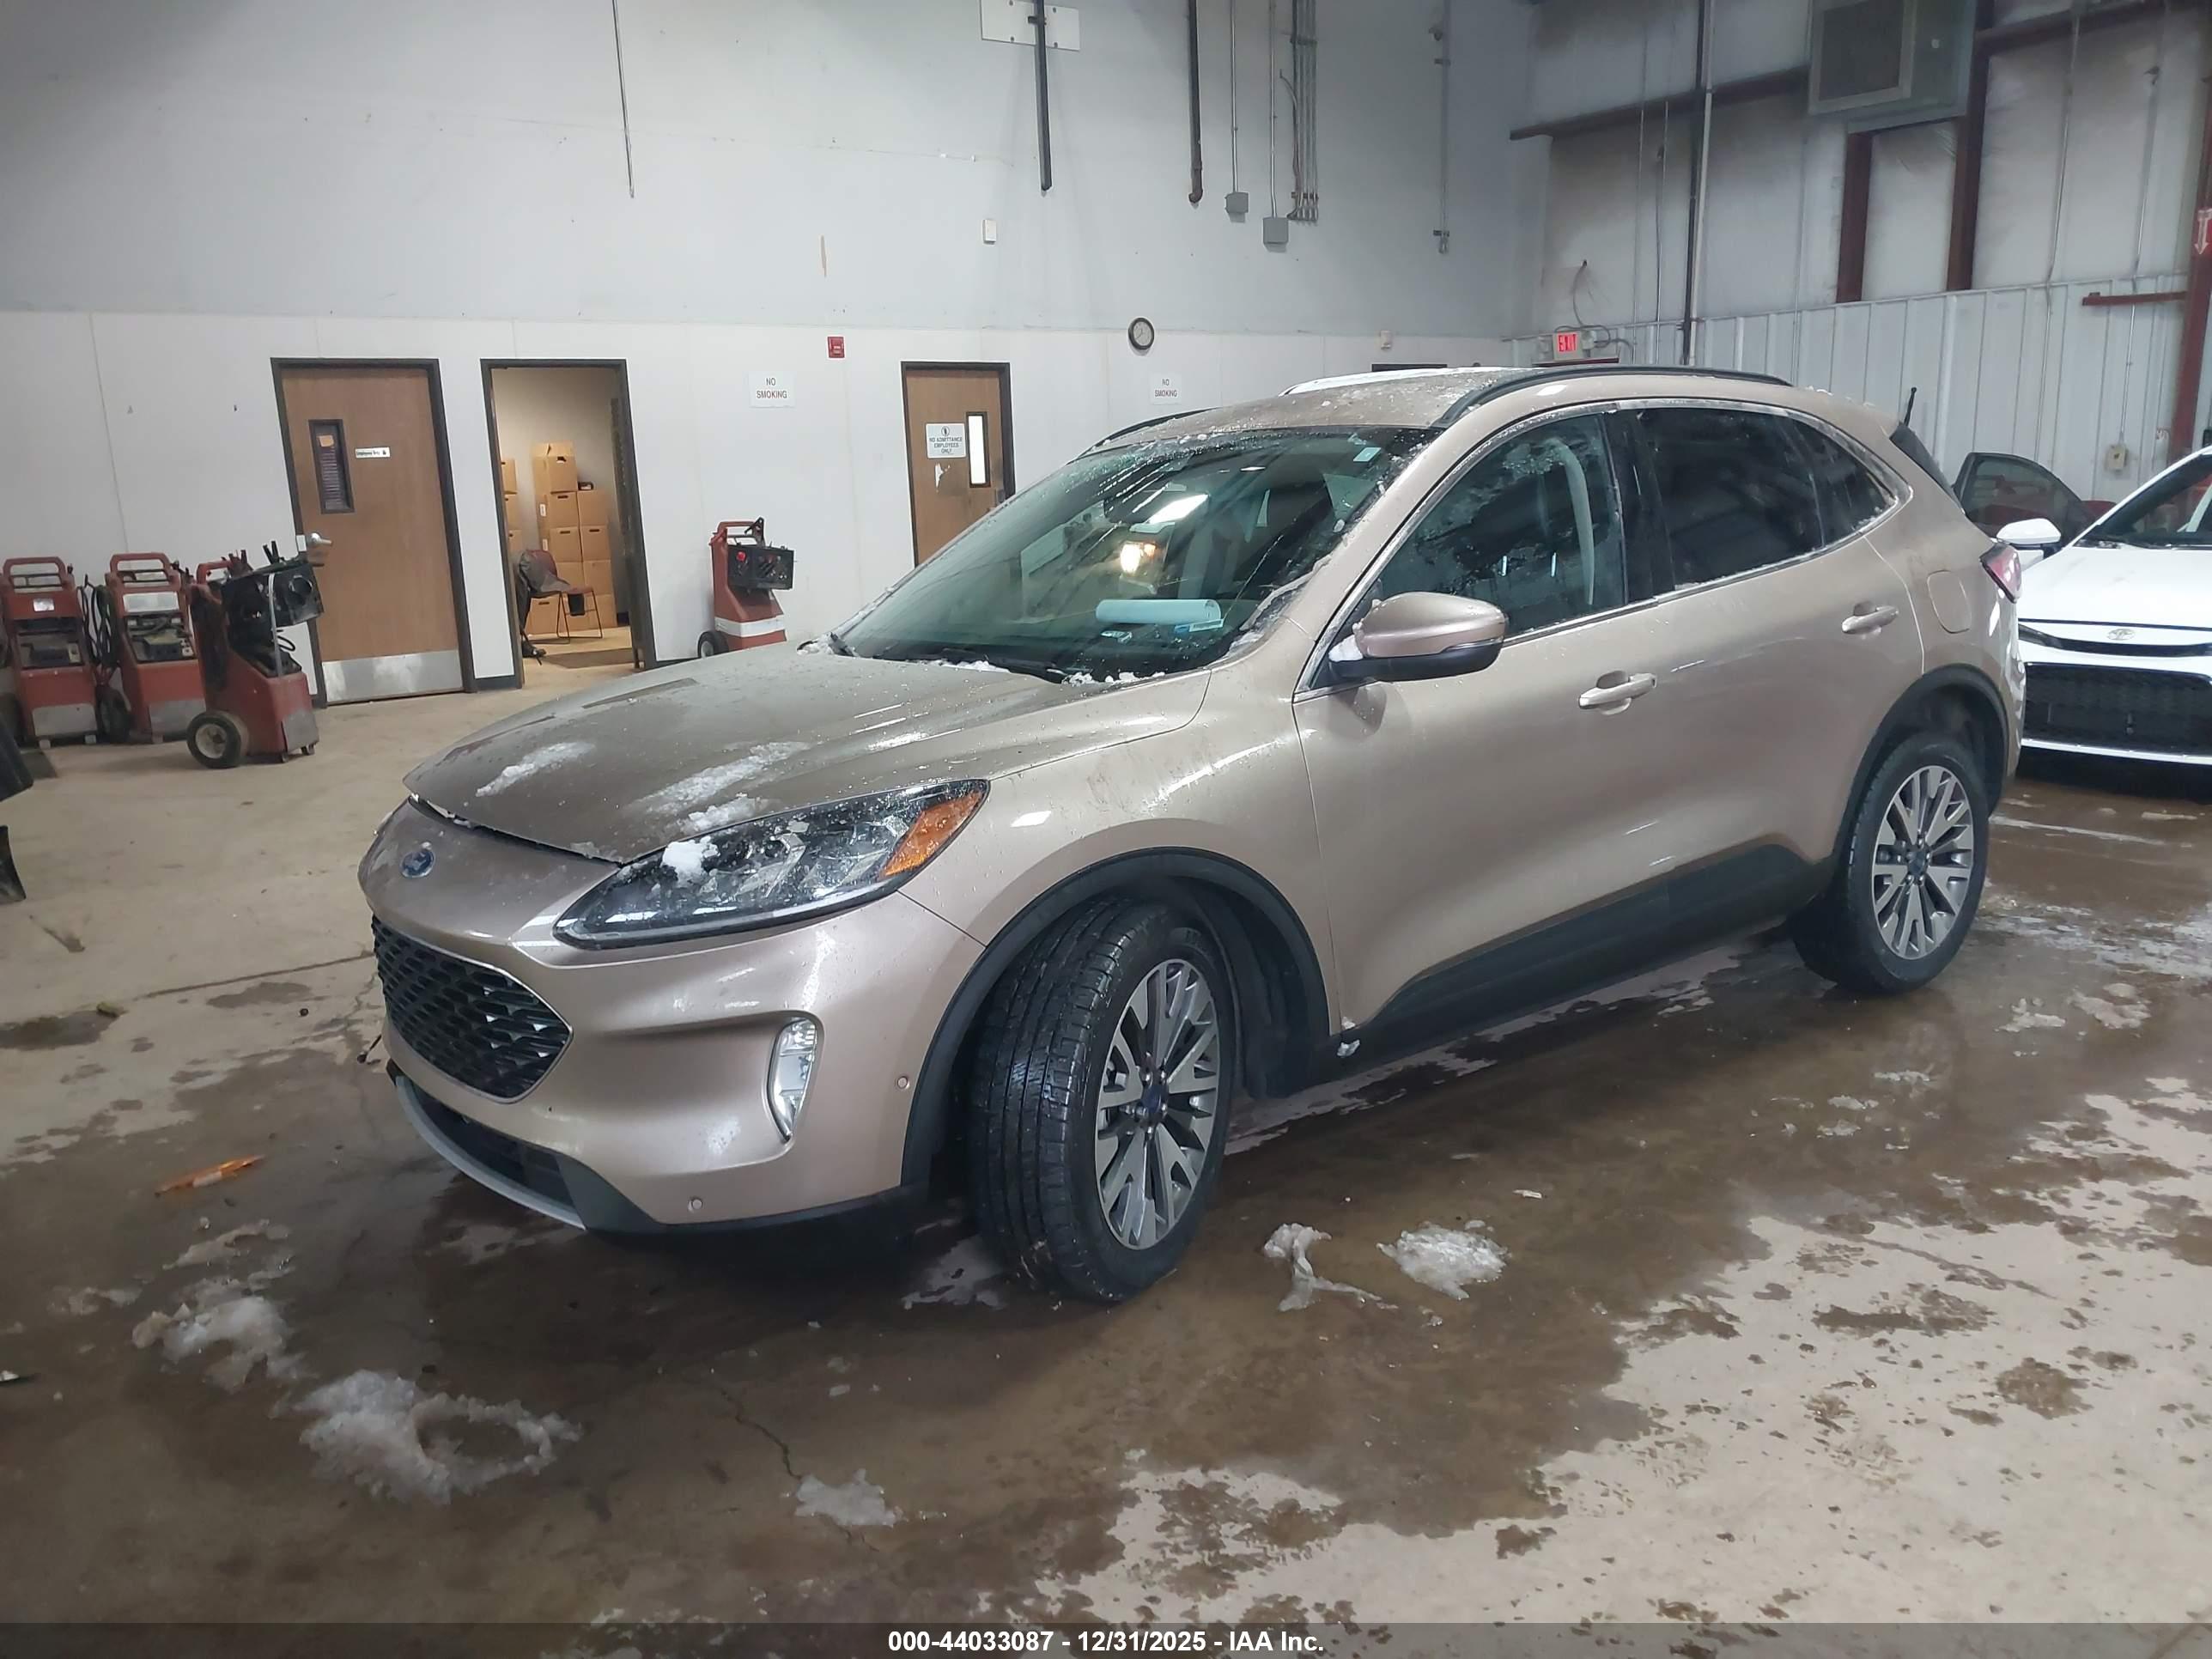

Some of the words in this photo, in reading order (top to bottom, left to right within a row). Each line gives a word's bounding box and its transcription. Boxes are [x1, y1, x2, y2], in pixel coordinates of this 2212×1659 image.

[766, 377, 776, 386] NO
[1162, 378, 1170, 386] NO
[756, 390, 787, 399] SMOKING
